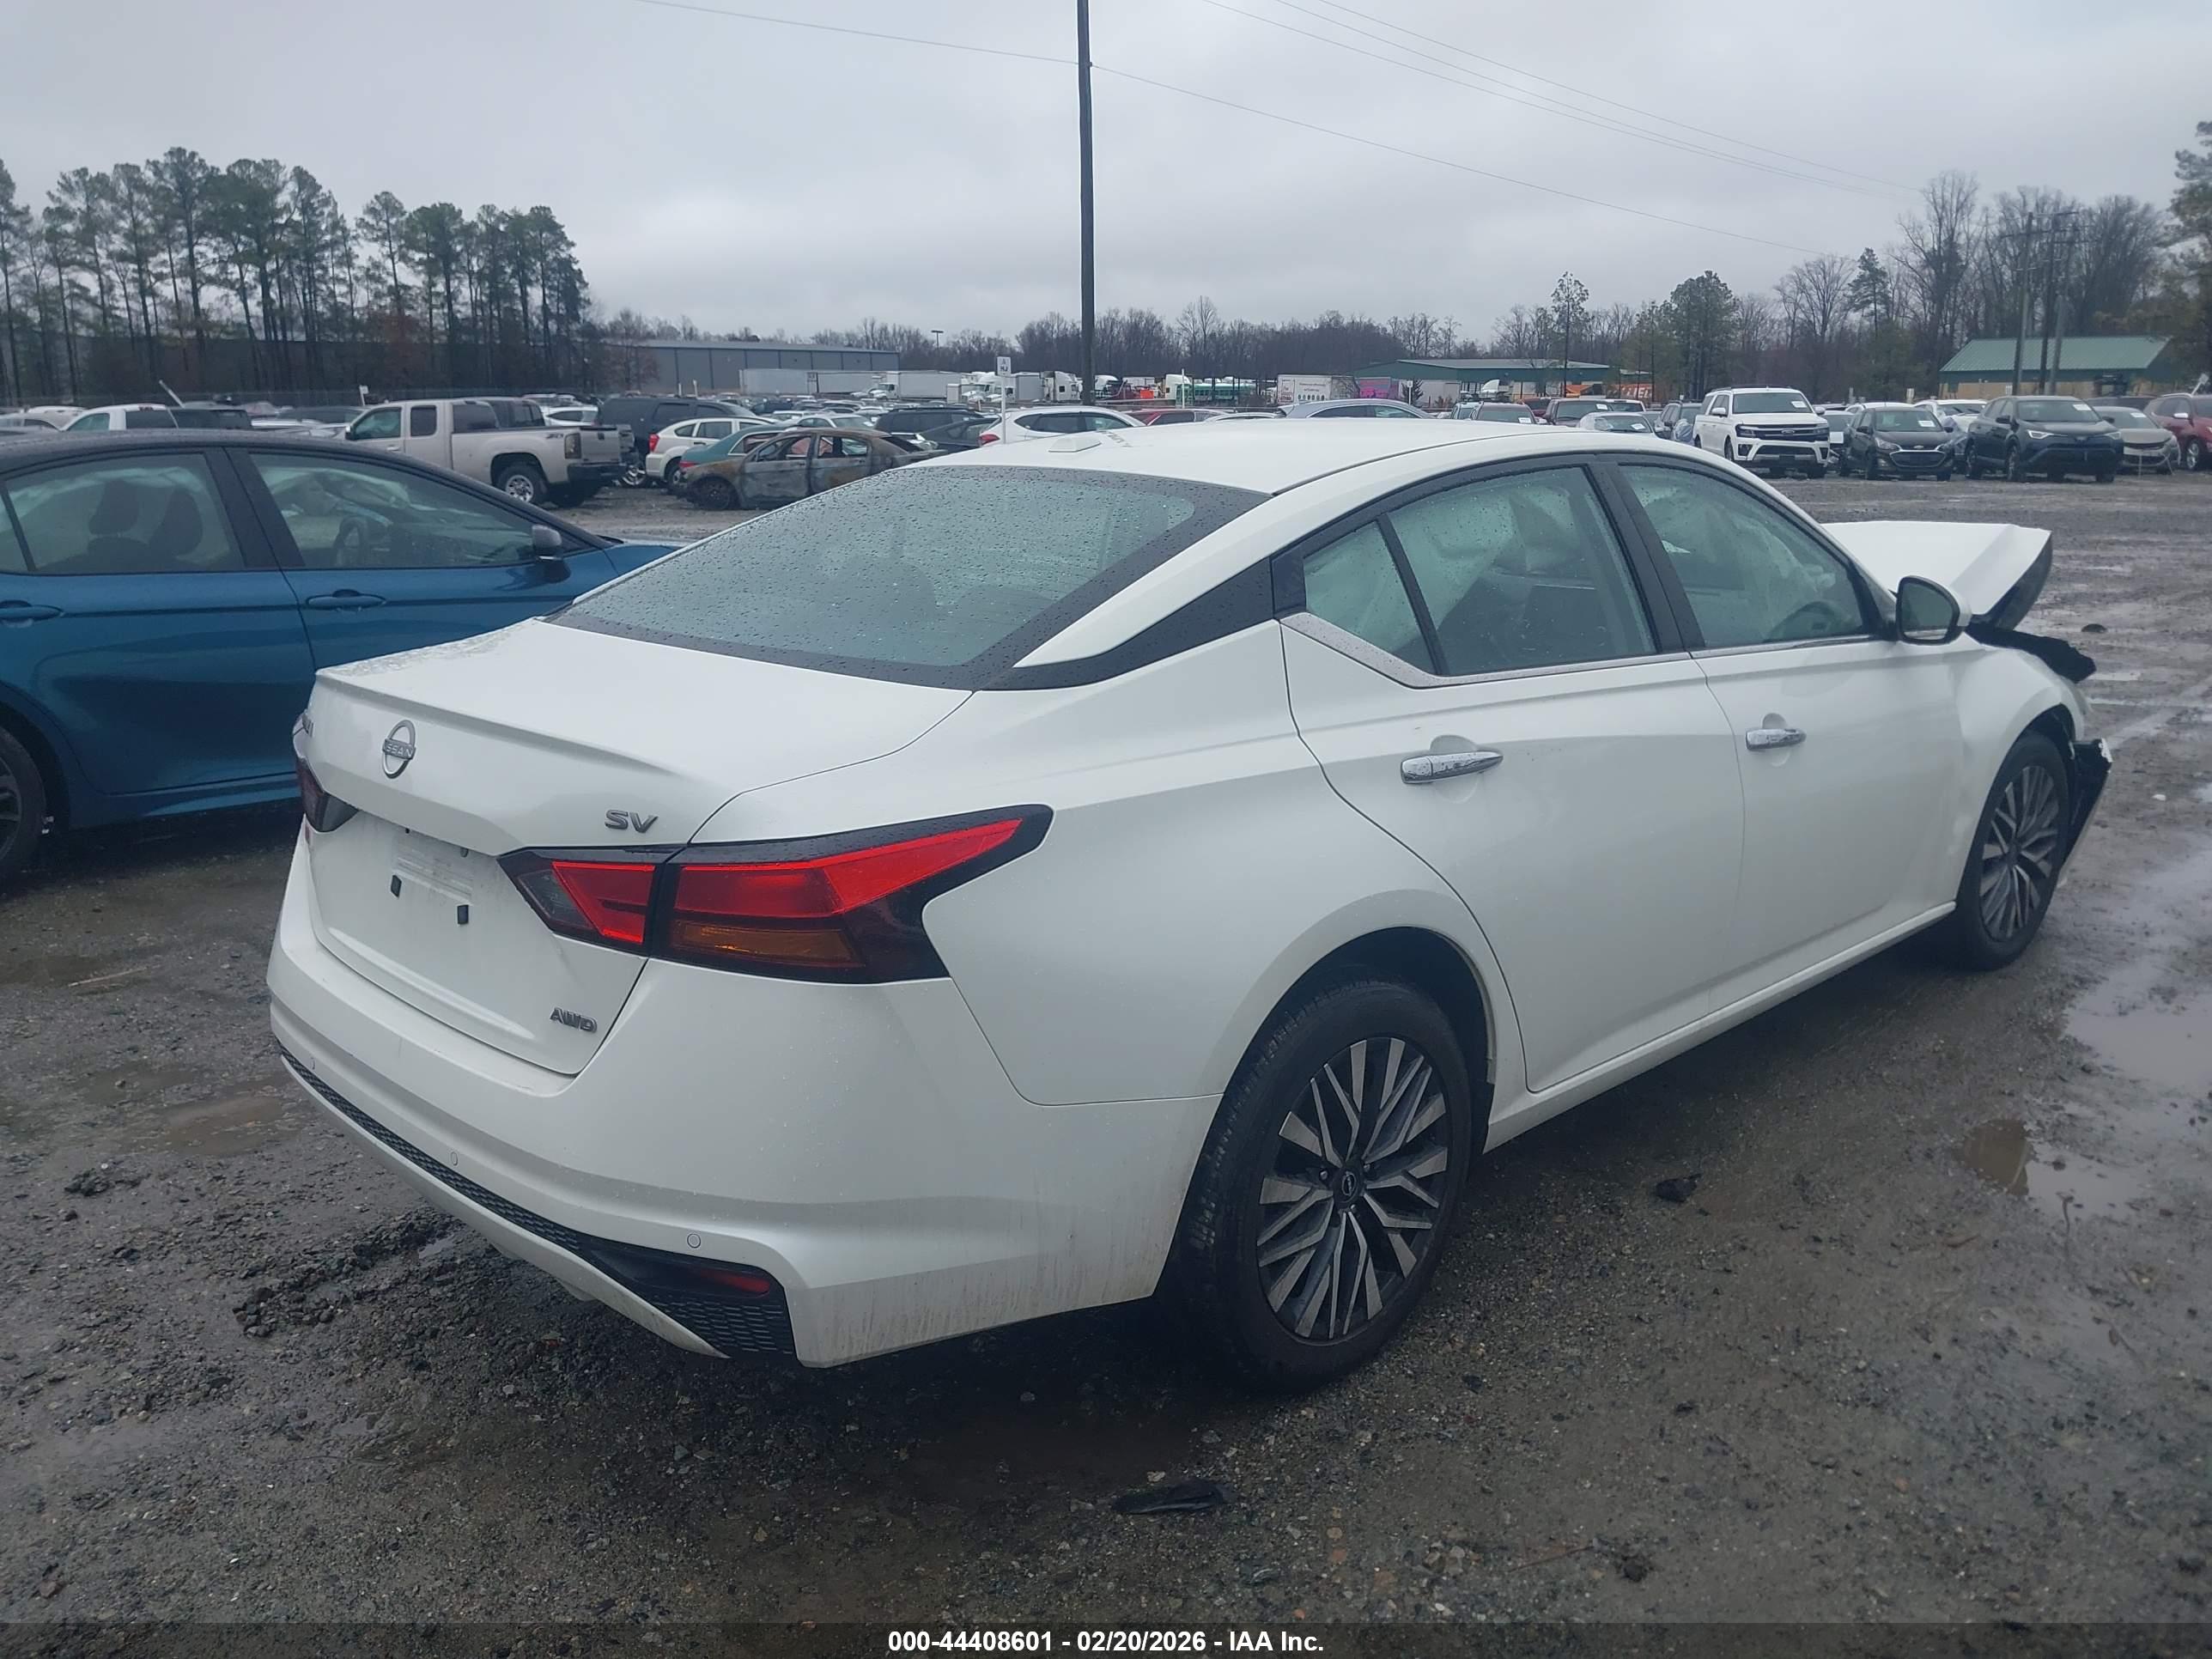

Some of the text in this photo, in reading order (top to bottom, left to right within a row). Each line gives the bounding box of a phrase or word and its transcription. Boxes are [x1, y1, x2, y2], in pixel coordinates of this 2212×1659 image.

[383, 739, 416, 759] SSAN
[605, 810, 659, 834] SV
[550, 1007, 598, 1033] AWD
